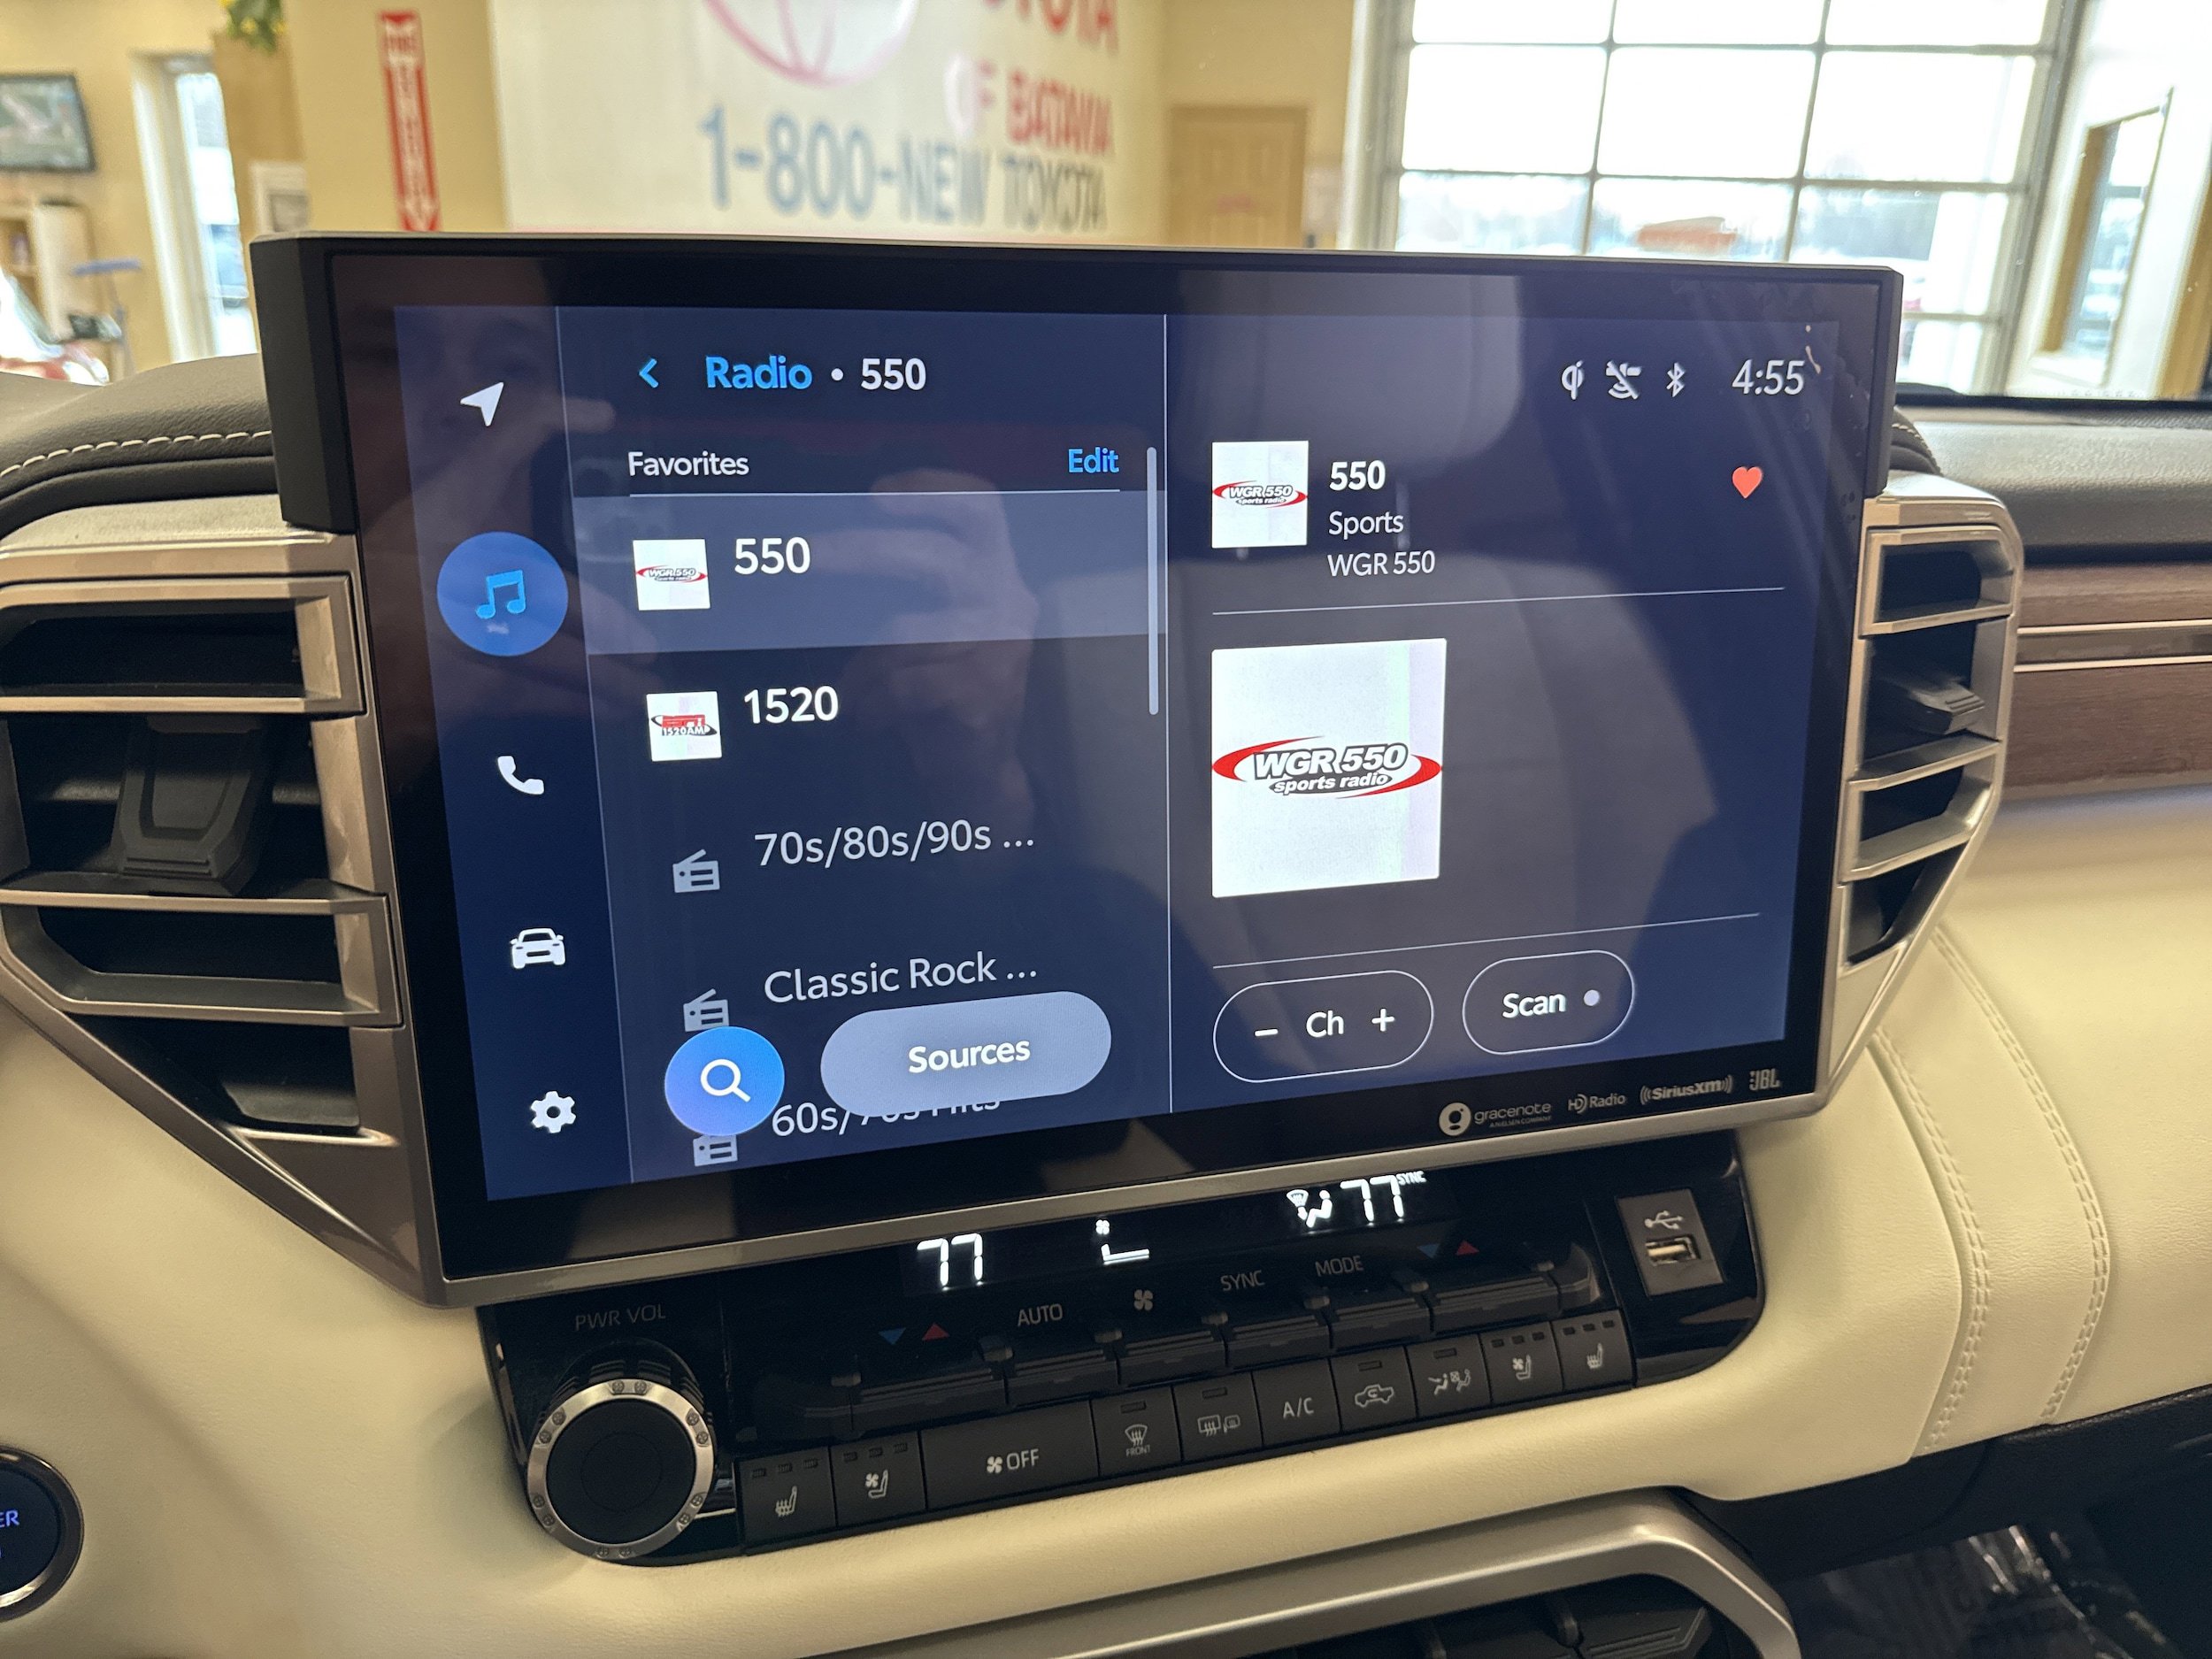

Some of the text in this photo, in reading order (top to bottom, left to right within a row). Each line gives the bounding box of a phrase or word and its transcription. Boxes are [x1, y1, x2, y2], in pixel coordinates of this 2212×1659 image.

[697, 103, 1109, 233] 1-800-NEW TOYOTA
[706, 356, 926, 391] Radio 550
[1732, 359, 1805, 396] 4:55
[628, 451, 749, 477] Favorites
[1068, 448, 1119, 474] Edit
[1329, 460, 1386, 491] 550
[1229, 485, 1293, 498] WGR 550
[1329, 511, 1404, 540] Sports
[734, 537, 810, 574] 550
[1327, 549, 1436, 578] WGR 550
[675, 568, 696, 577] 550
[744, 686, 838, 724] 1520
[1254, 742, 1409, 780] WGR 550
[1272, 772, 1390, 795] sports radio
[755, 819, 991, 868] 70s/80s/90s
[764, 961, 900, 1004] Classic
[910, 951, 997, 990] Rock
[1502, 989, 1567, 1020] Scan
[1306, 1010, 1344, 1038] Ch
[908, 1040, 1031, 1074] Sources
[1749, 1068, 1781, 1091] JBL
[1474, 1102, 1551, 1125] gracenote
[1589, 1092, 1626, 1109] Radio
[1396, 1171, 1427, 1186] SYNC
[1340, 1175, 1404, 1222] 77
[917, 1233, 984, 1286] 77
[1315, 1255, 1364, 1278] MODE
[1220, 1270, 1266, 1292] SYNC
[575, 1303, 666, 1331] PWR VOL
[1017, 1303, 1064, 1327] AUTO
[1283, 1395, 1315, 1419] A/C
[1006, 1448, 1040, 1471] OFF
[1125, 1444, 1151, 1457] FRONT
